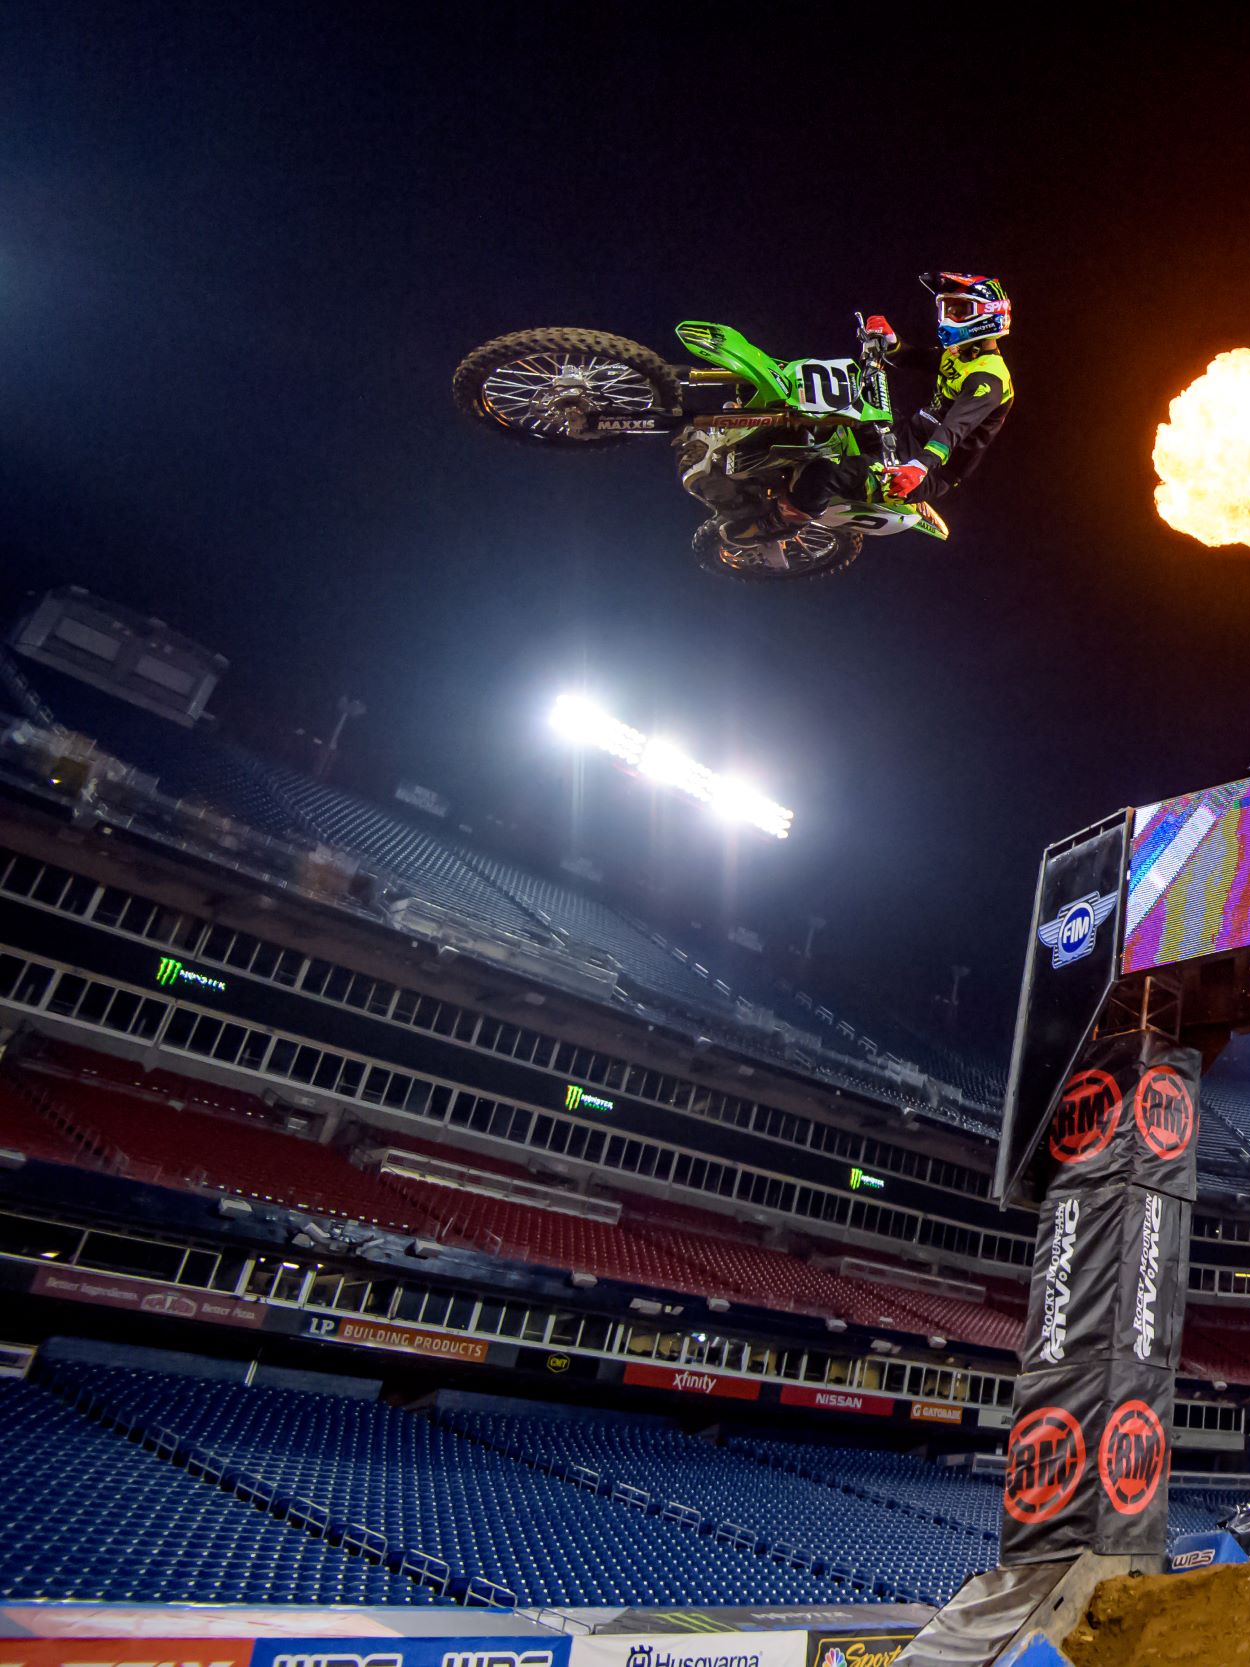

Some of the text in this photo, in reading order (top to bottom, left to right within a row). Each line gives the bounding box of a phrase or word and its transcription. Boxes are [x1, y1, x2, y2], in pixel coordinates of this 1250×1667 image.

[878, 372, 890, 412] RENTHA
[598, 419, 655, 430] MAXXIS
[1063, 916, 1090, 944] FIM
[1057, 1090, 1105, 1137] RM
[1042, 1202, 1066, 1339] ROCKY MOUNTAIN
[1133, 1193, 1153, 1332] ROCKY MOUNTAIN
[310, 1318, 336, 1336] LP
[343, 1325, 483, 1358] BUILDING PRODUCTS
[673, 1372, 716, 1394] xfinity
[815, 1392, 862, 1409] NISSAN
[1013, 1440, 1068, 1492] RM
[1172, 1549, 1216, 1570] WPS
[845, 1643, 902, 1667] Sport
